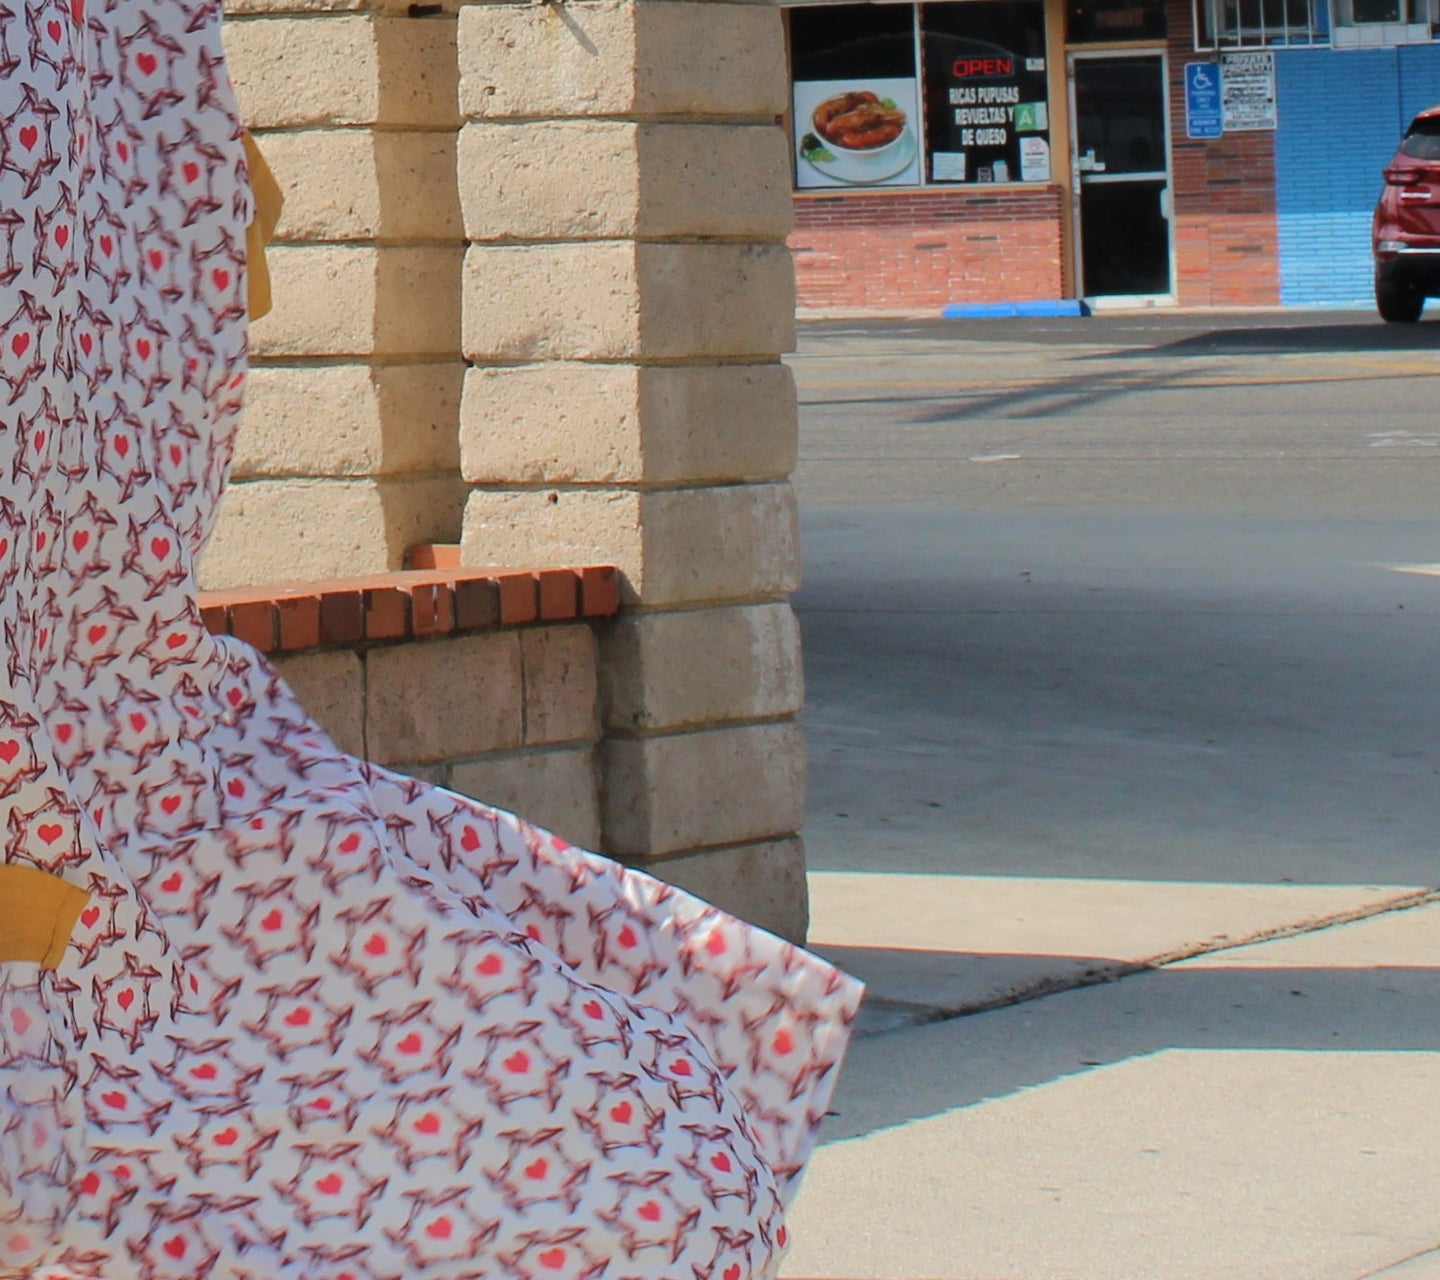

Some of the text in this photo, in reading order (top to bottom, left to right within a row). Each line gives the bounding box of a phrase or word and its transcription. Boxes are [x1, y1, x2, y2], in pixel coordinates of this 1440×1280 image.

[953, 59, 1012, 77] OPEN
[949, 87, 1019, 105] RICAS PUPUSAS
[955, 106, 1014, 125] REVUELTAS Y
[962, 128, 1006, 145] DE QUESO
